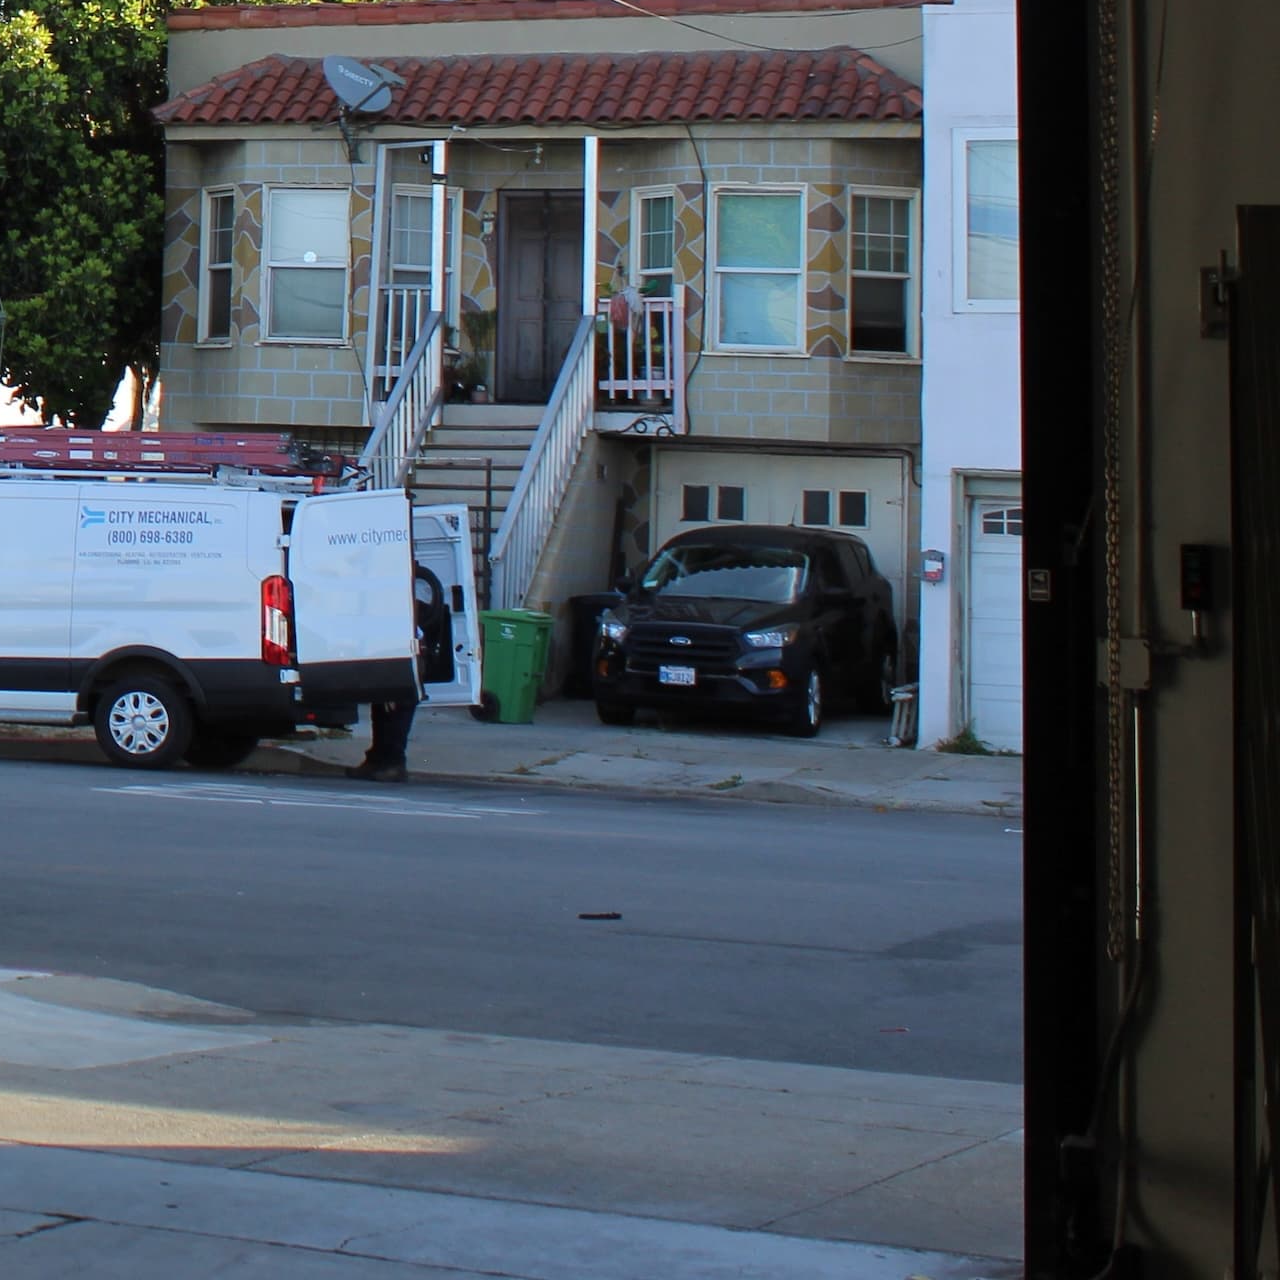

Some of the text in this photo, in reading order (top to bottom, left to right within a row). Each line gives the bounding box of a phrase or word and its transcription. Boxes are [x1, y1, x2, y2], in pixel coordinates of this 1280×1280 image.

[108, 510, 135, 524] CITY
[107, 530, 194, 546] (800) 698-6380
